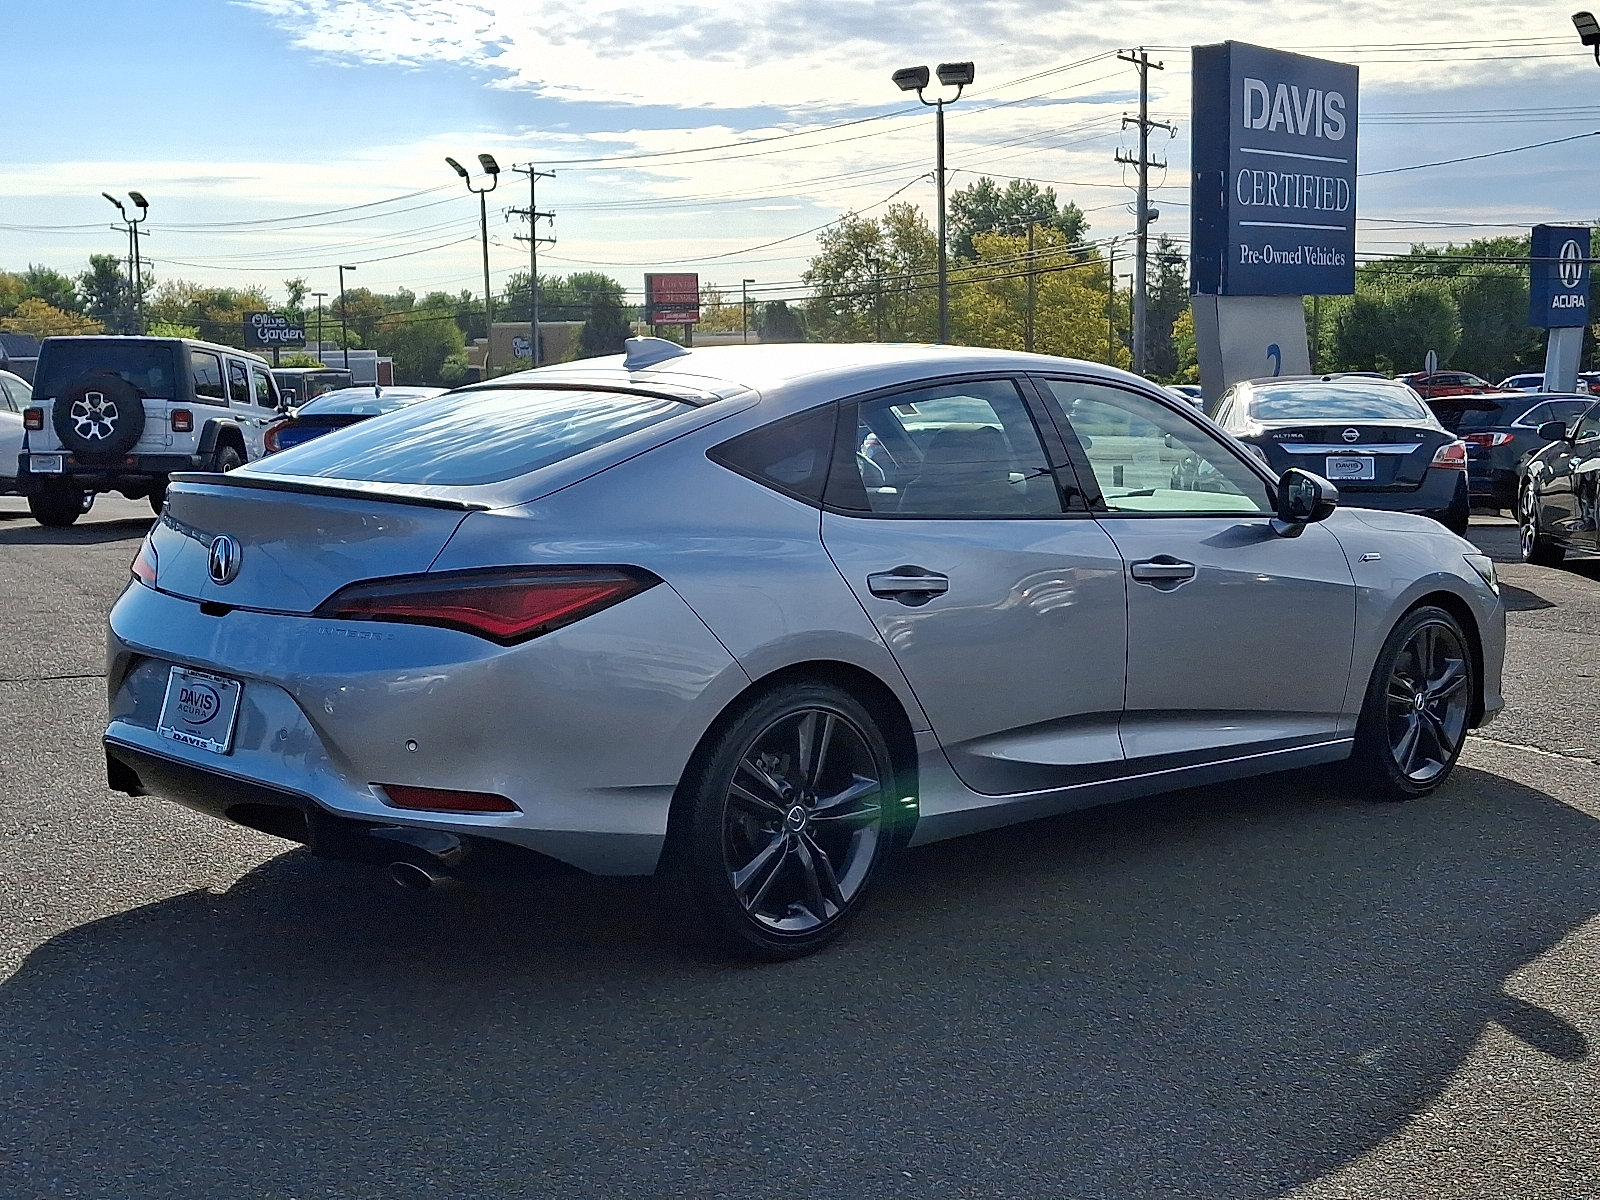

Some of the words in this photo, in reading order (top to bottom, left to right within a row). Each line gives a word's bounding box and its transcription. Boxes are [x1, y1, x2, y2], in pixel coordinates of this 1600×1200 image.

[1243, 77, 1346, 141] DAVIS
[1236, 168, 1350, 212] CERTIFIED
[1240, 244, 1302, 265] Pre-Owned
[1303, 245, 1346, 266] Vehicles
[1551, 294, 1586, 309] ACURA
[251, 313, 286, 328] Olive
[257, 327, 305, 343] Garden
[180, 687, 213, 710] DAVIS
[177, 704, 207, 718] ACURA
[172, 733, 208, 749] DAVIS
